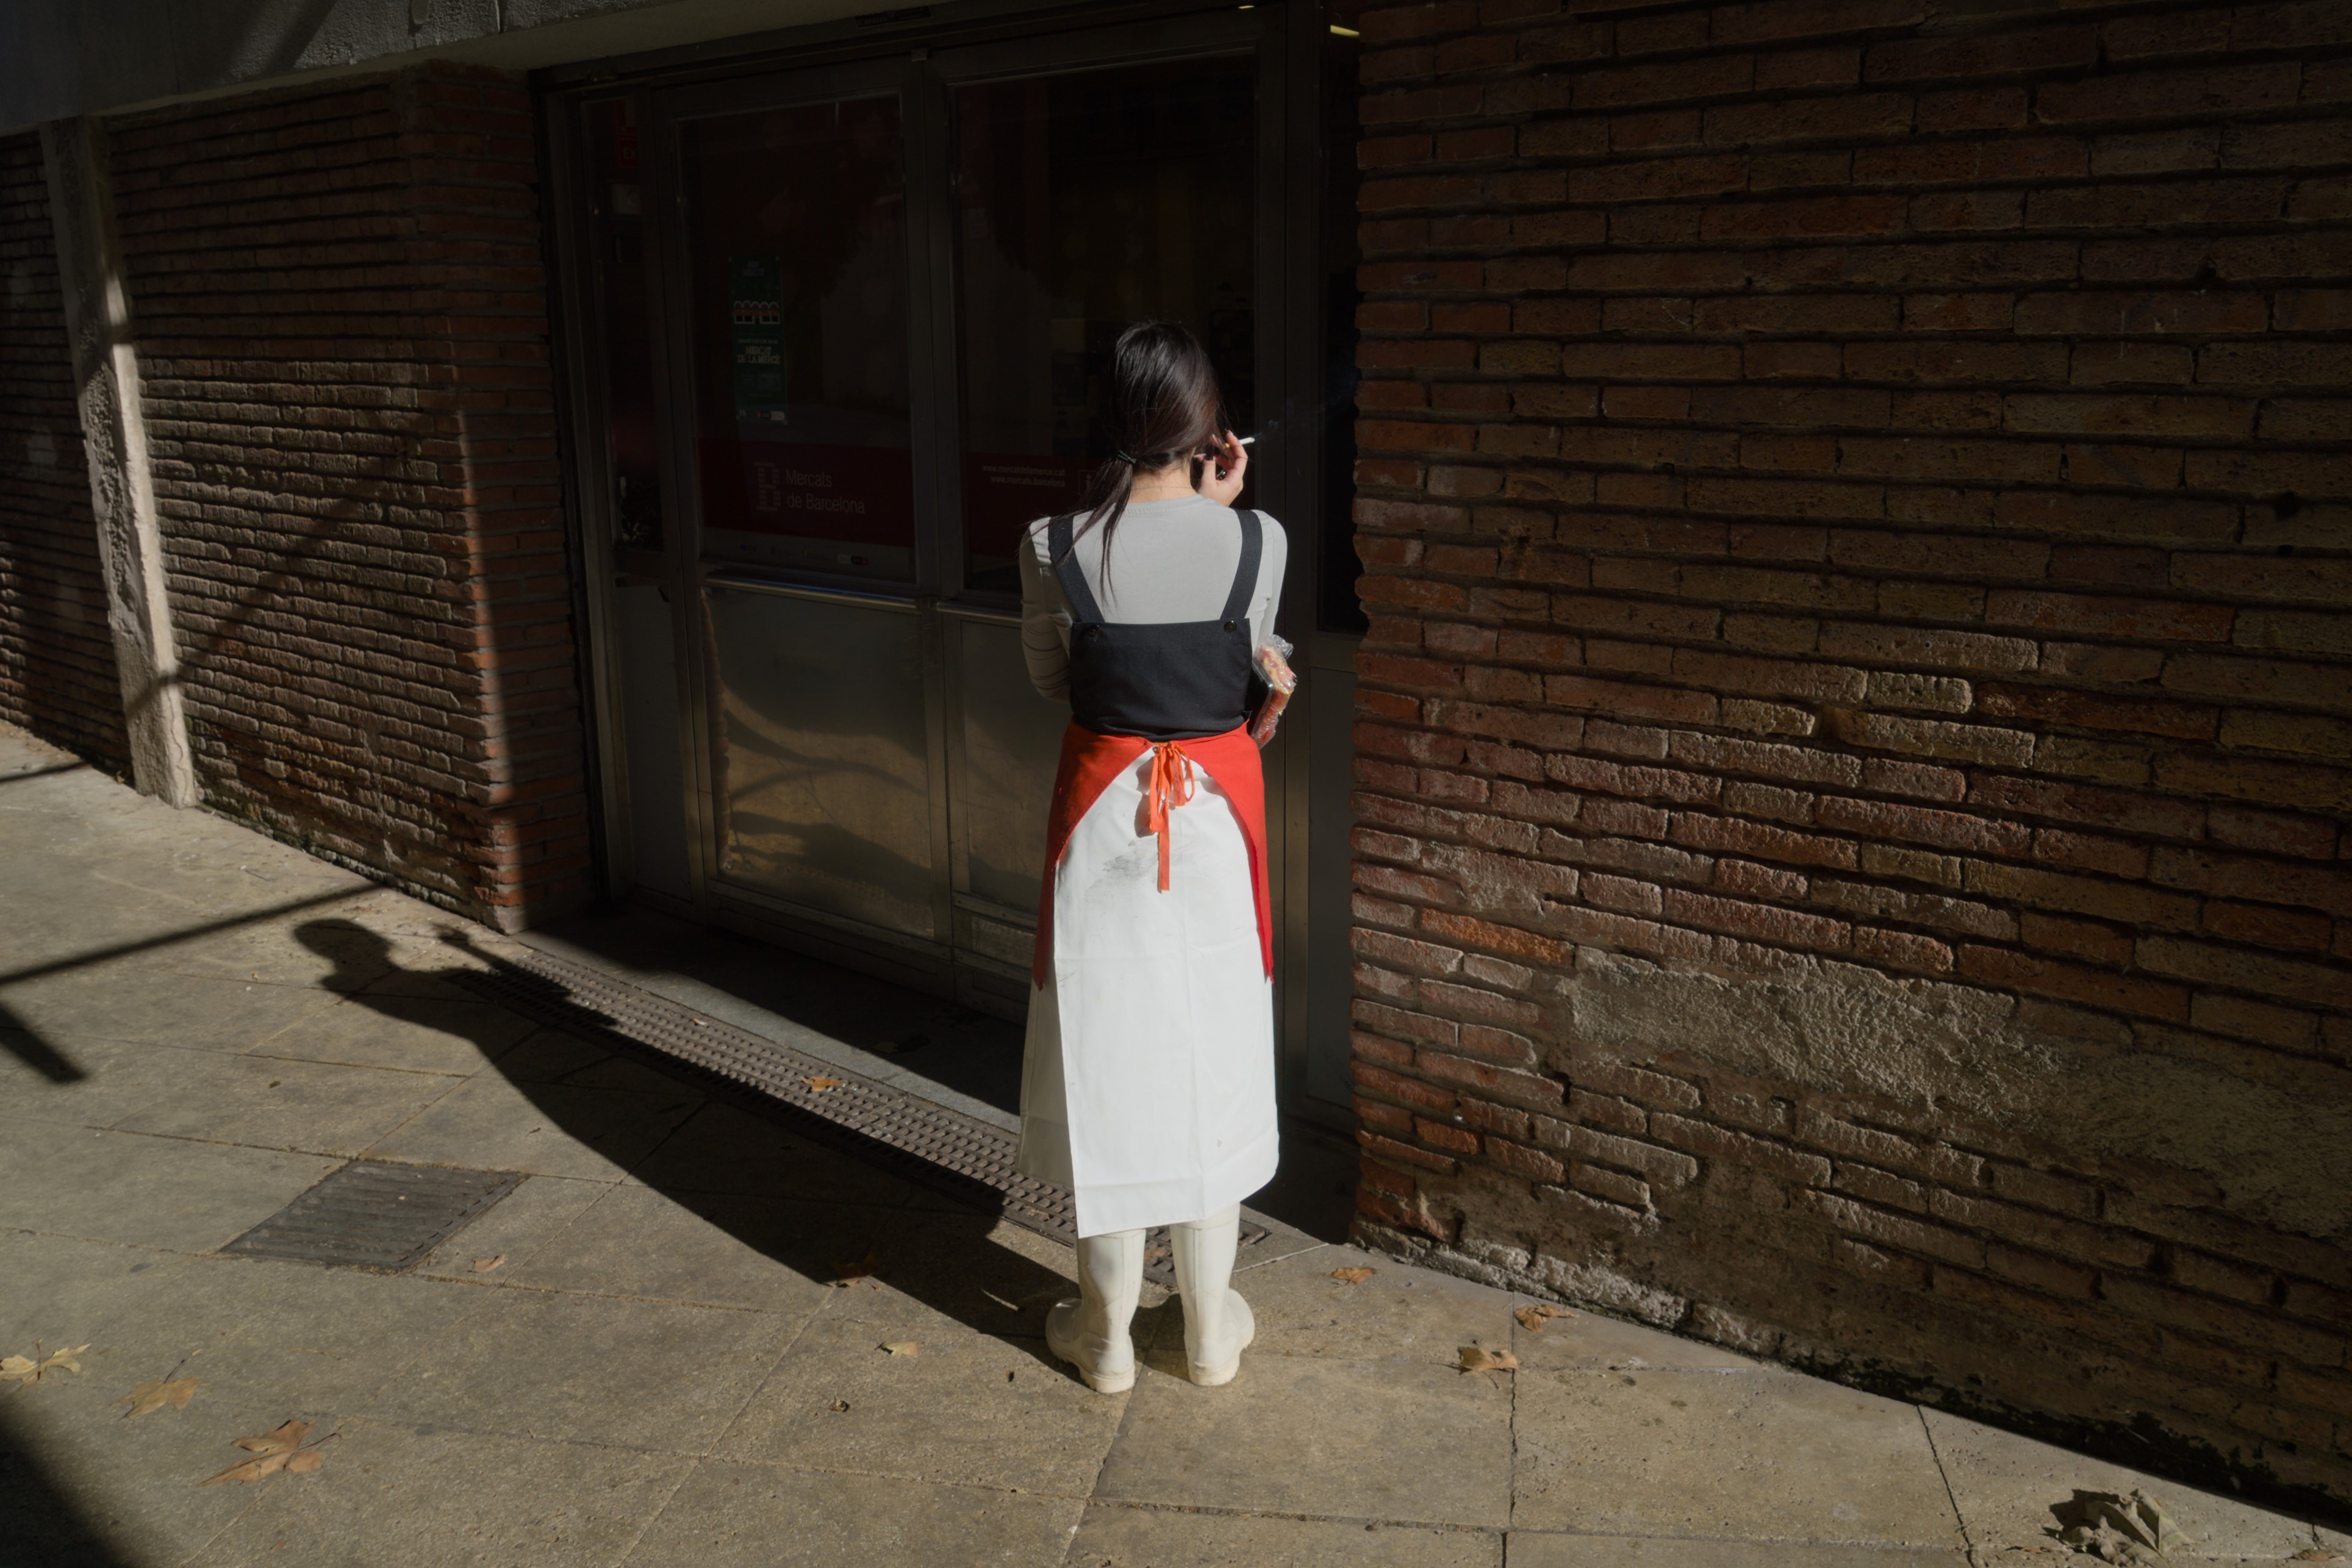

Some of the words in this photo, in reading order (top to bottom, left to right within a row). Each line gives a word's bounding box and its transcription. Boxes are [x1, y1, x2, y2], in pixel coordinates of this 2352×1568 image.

[737, 354, 747, 363] DE
[748, 354, 757, 363] LA
[981, 465, 1065, 476] www.mercatdelamerce.cat
[785, 468, 833, 489] Mercats
[991, 476, 1065, 487] www.mercats.barcelona
[787, 492, 802, 509] de
[806, 493, 866, 515] Barcelona
